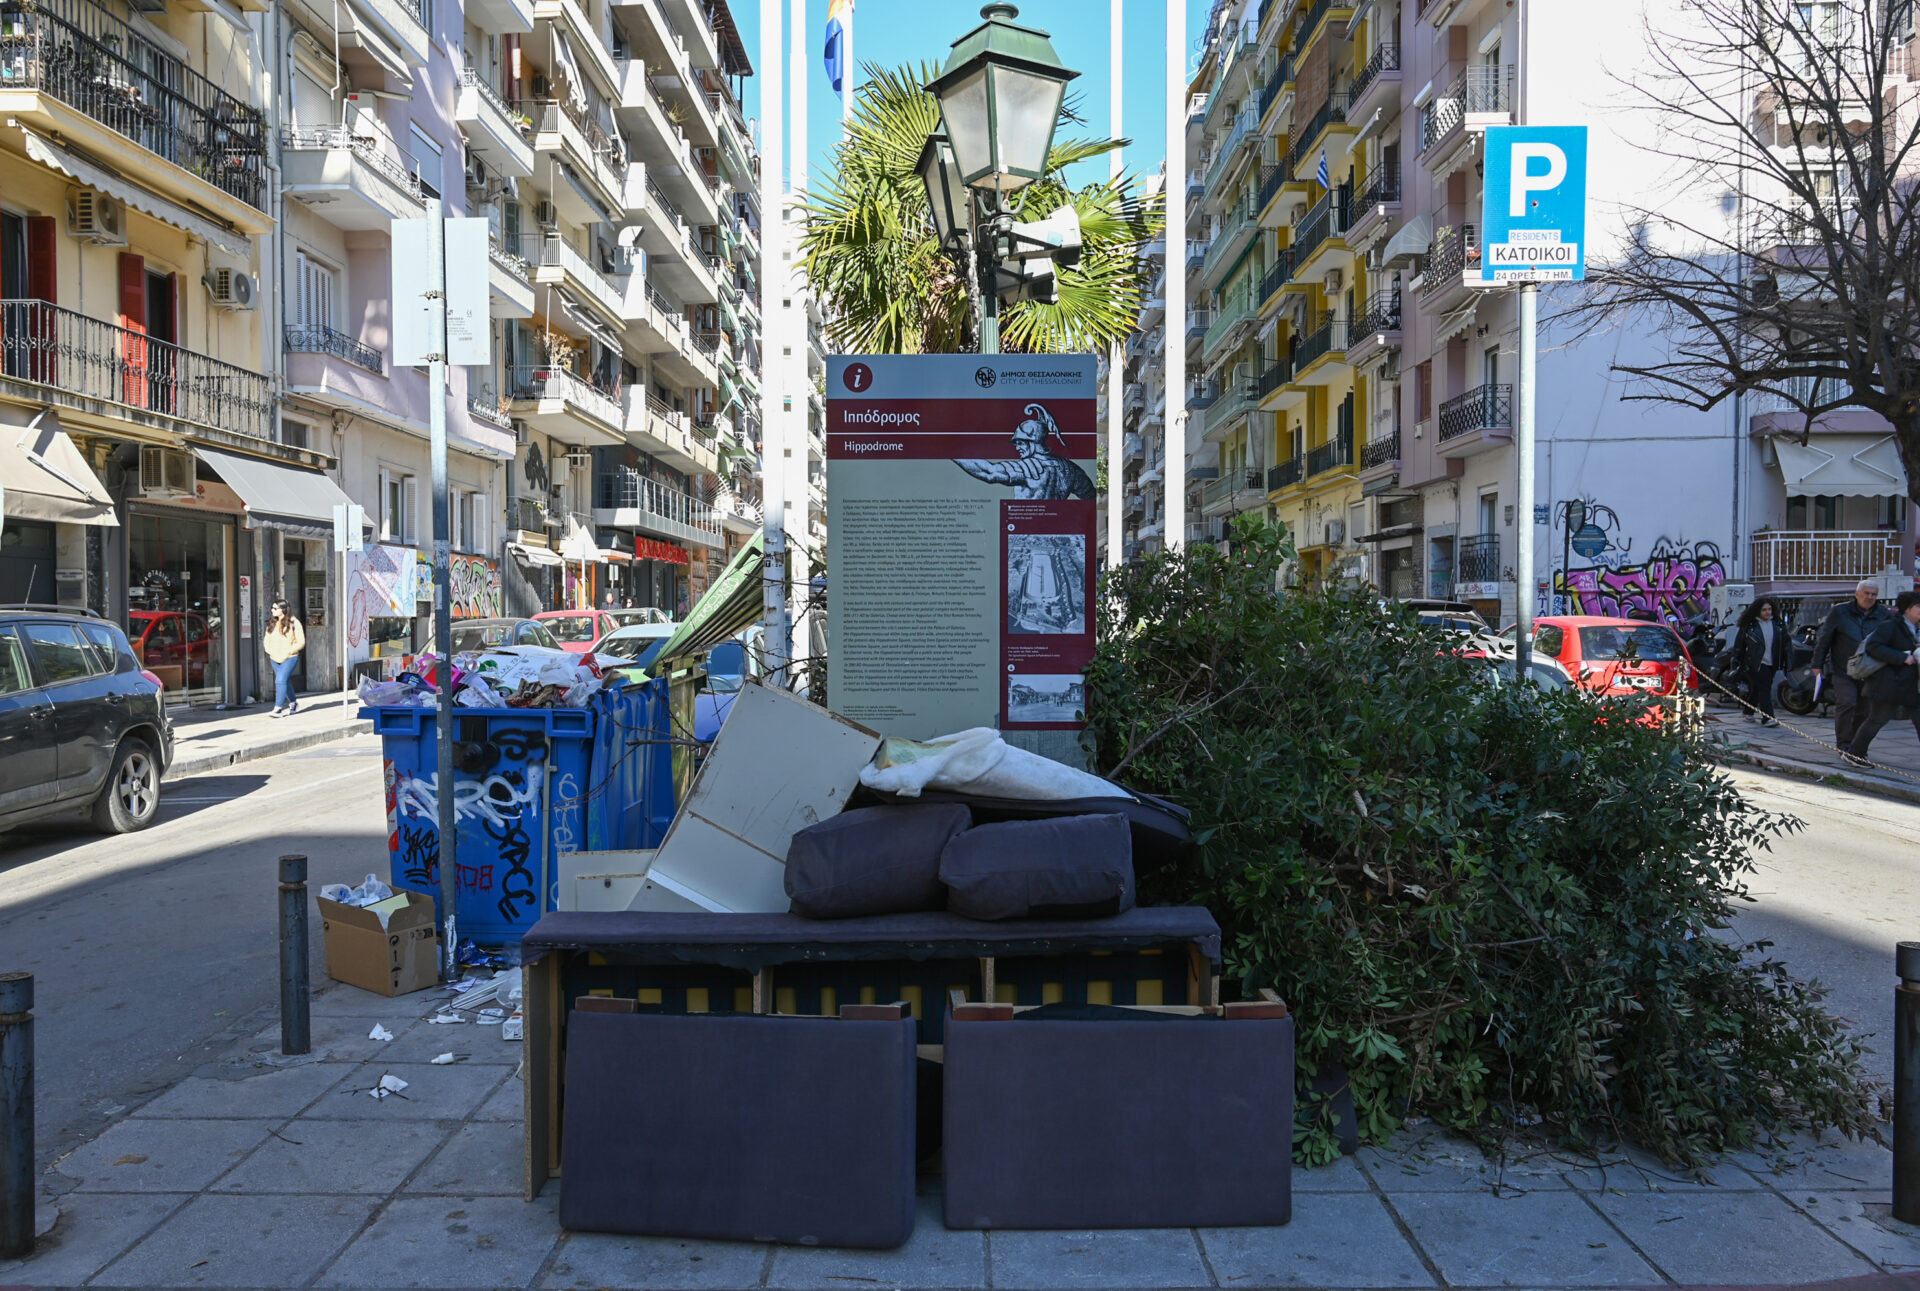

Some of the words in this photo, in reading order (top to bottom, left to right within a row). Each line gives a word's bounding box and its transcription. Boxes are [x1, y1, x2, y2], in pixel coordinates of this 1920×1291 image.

[1509, 142, 1568, 217] P
[1510, 231, 1559, 241] RESIDENTS
[1496, 247, 1571, 261] ΚΑΤΟΙΚΟΙ
[1495, 271, 1507, 281] 24
[1510, 271, 1536, 280] ΩΡΕΣ
[1544, 271, 1550, 280] 7
[1553, 270, 1572, 279] ΗΜ.
[844, 409, 921, 427] Ιππόδρομος
[844, 440, 904, 454] Hippodrome
